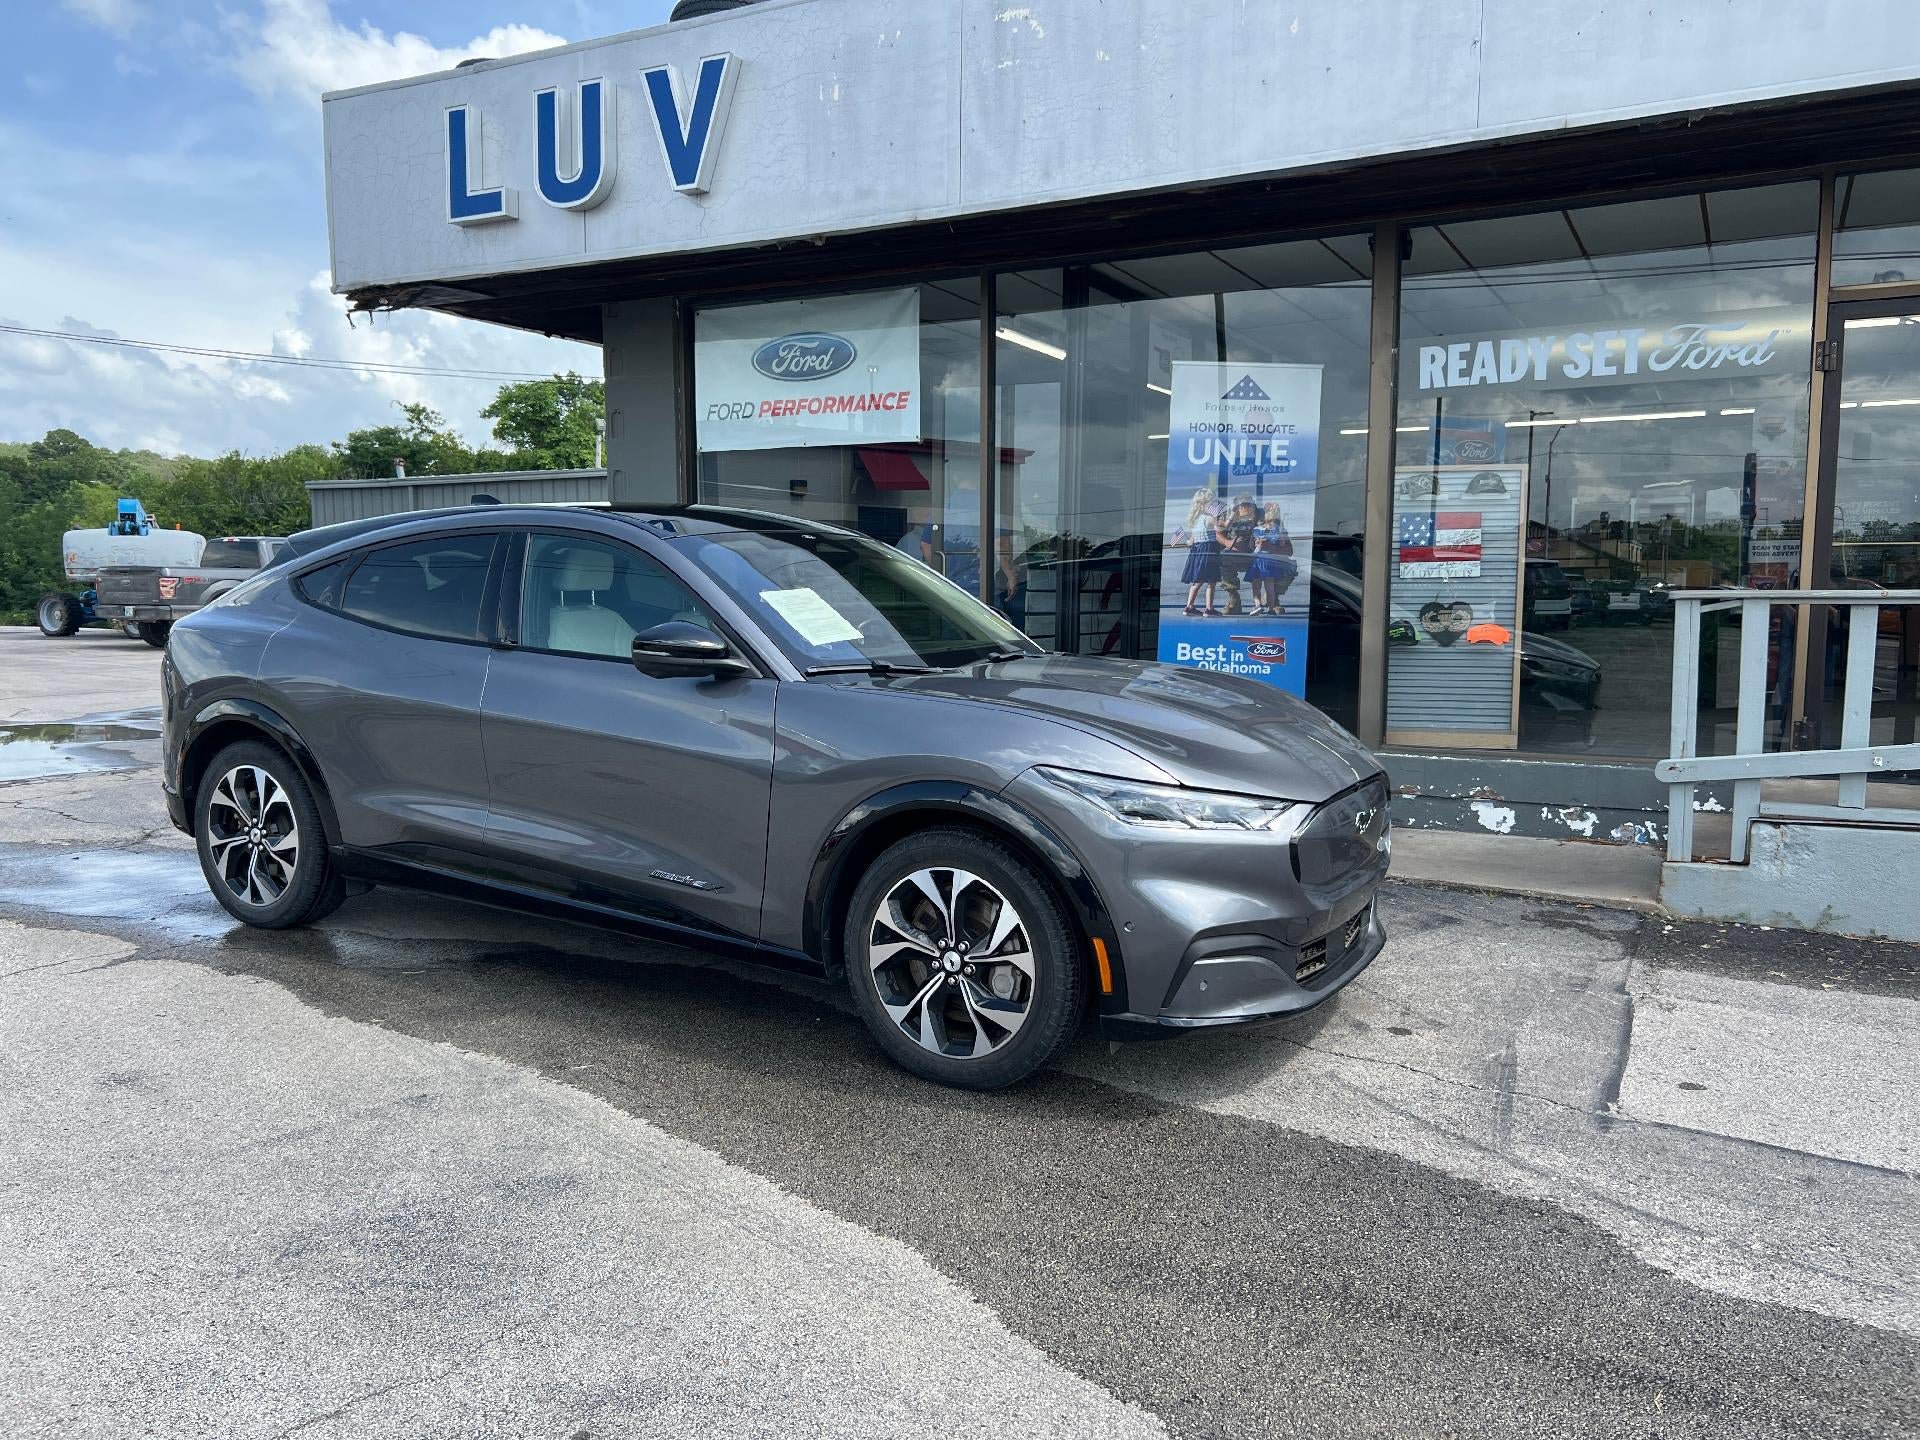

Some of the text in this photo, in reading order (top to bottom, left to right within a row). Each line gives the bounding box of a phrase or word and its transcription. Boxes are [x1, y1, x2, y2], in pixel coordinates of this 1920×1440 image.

[445, 52, 738, 225] LUV
[772, 341, 834, 374] Ford
[1419, 335, 1556, 389] READY
[1562, 328, 1647, 379] SET
[1648, 322, 1780, 371] Ford
[707, 391, 911, 421] FORD PERFORMANCE
[1189, 422, 1298, 435] HONOR. EDUCATE.
[1187, 438, 1298, 467] UNITE.
[1461, 441, 1488, 458] Ford
[1177, 642, 1279, 661] Best in Ford
[1198, 660, 1271, 675] Oklahoma
